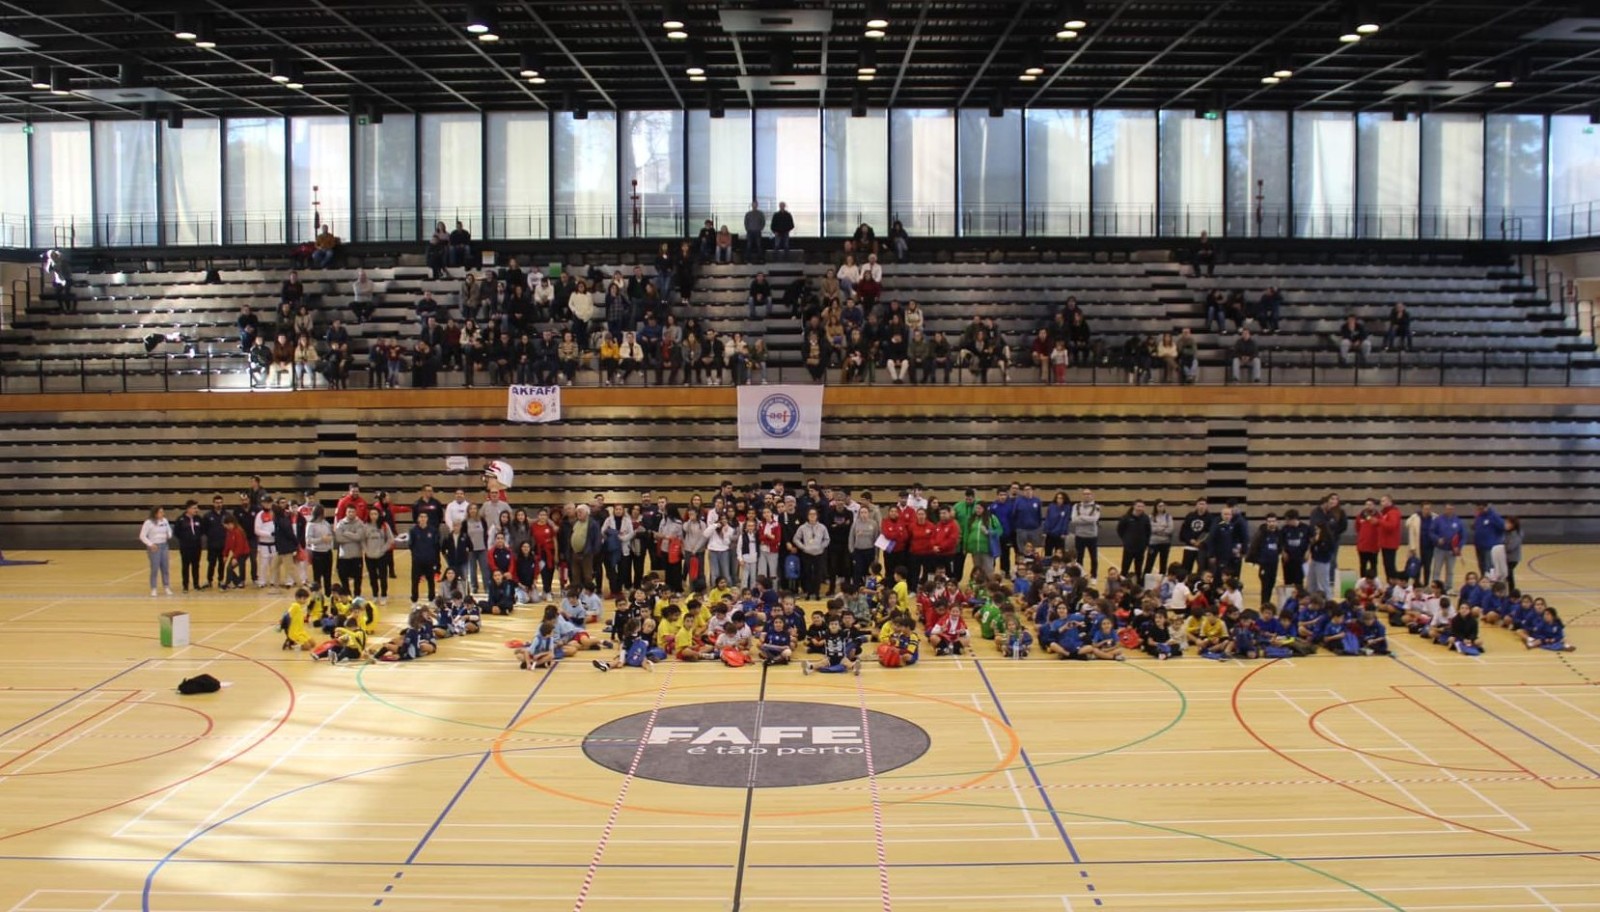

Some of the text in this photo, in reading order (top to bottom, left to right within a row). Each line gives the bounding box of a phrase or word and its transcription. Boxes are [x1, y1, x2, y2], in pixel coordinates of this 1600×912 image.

[647, 726, 863, 744] FAFE
[687, 745, 864, 756] é tão perto
